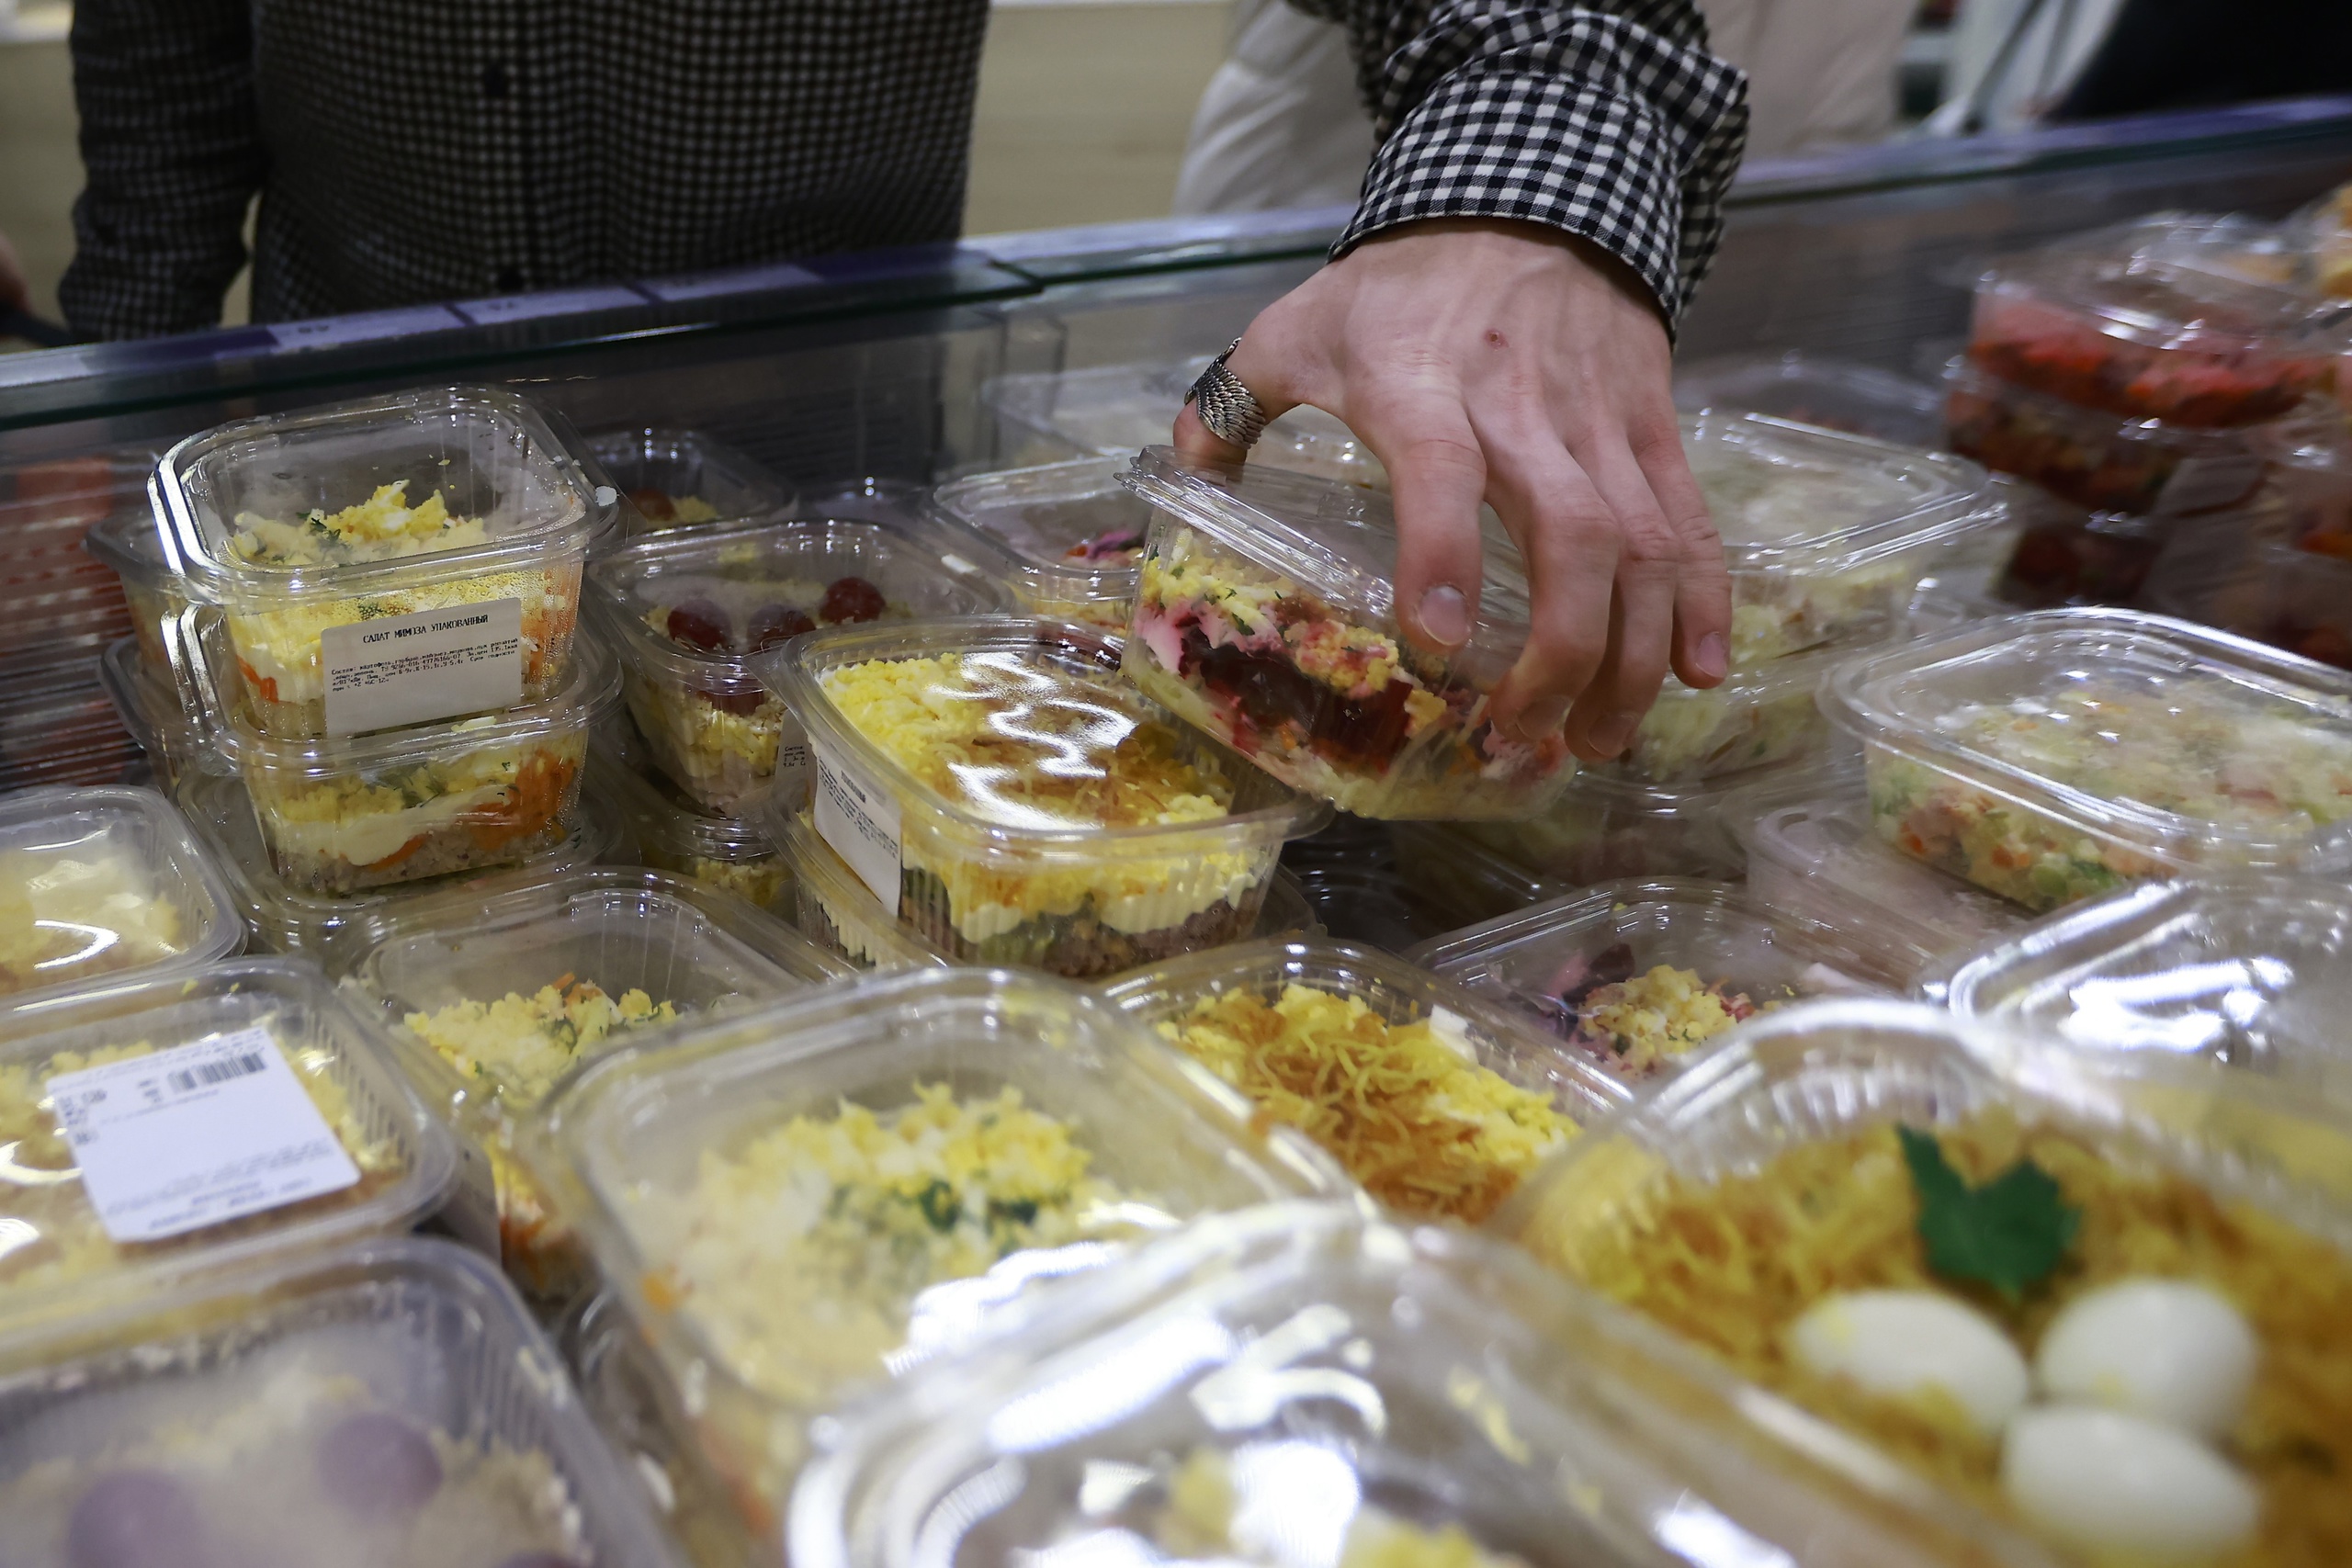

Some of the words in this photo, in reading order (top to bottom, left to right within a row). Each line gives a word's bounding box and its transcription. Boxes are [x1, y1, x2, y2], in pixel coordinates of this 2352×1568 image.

[363, 631, 390, 644] САЛАТ
[394, 626, 426, 639] МИМОЗА
[431, 615, 489, 632] УПАКОВАННЫЙ
